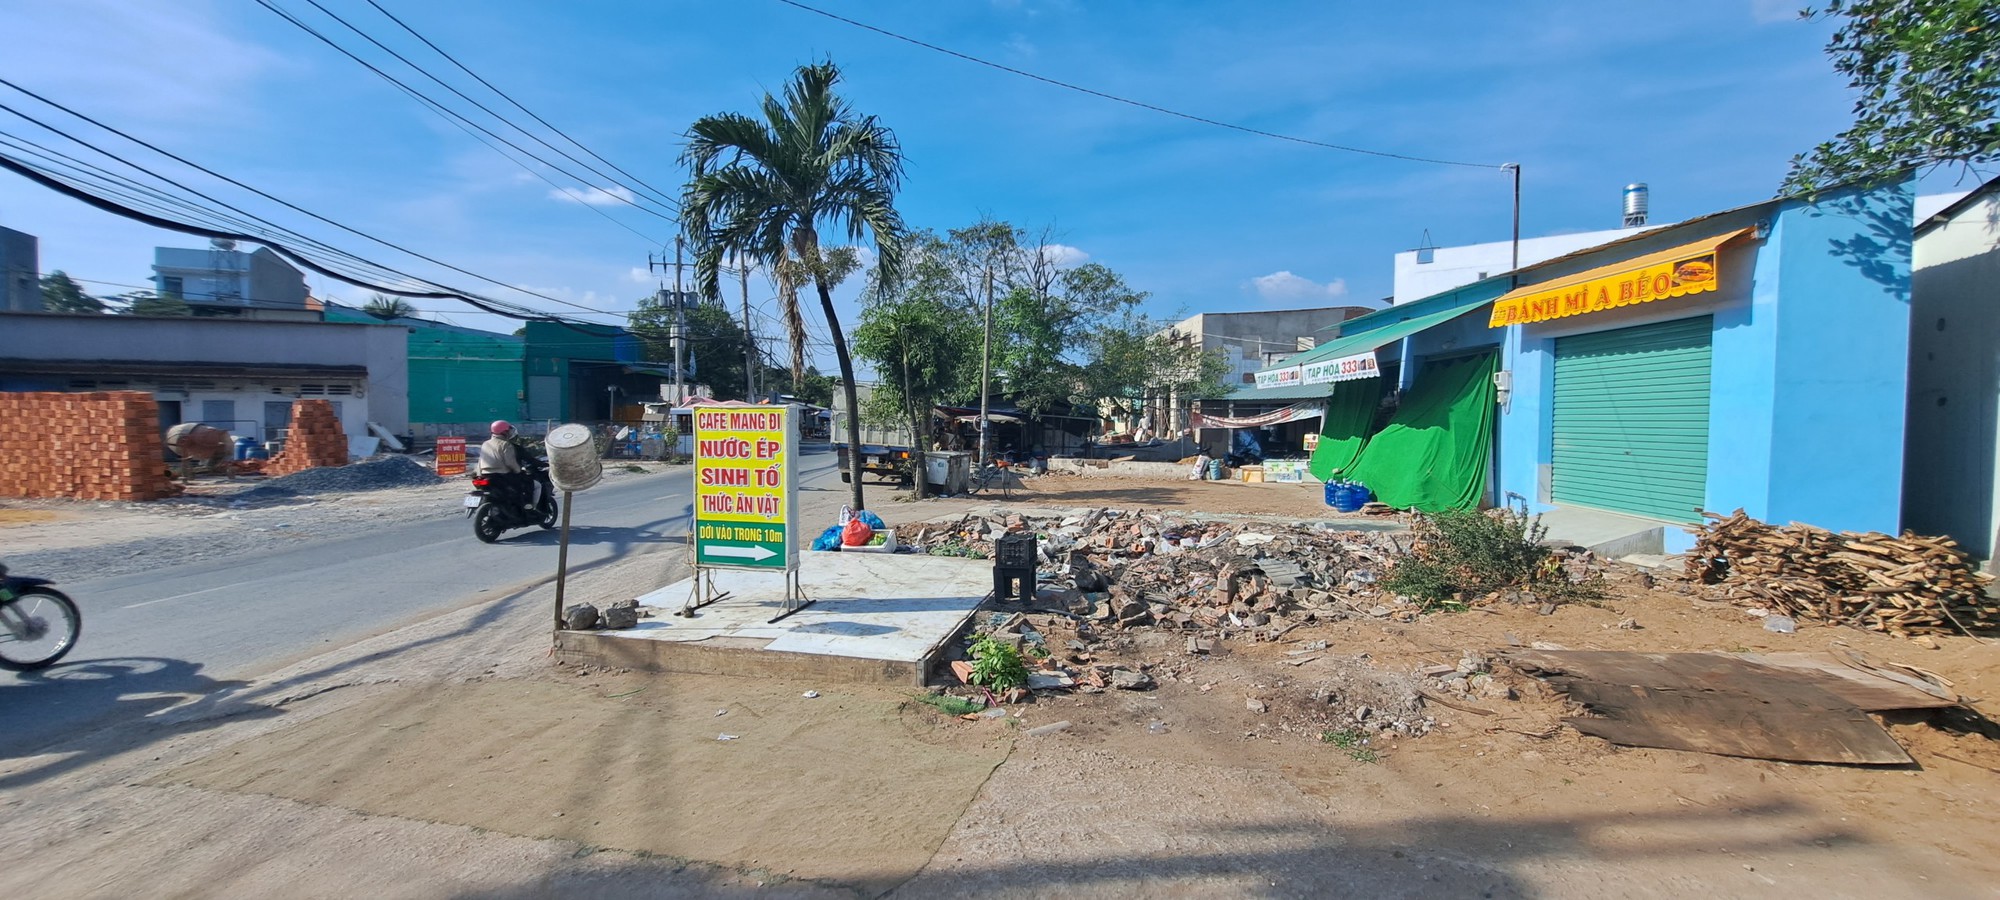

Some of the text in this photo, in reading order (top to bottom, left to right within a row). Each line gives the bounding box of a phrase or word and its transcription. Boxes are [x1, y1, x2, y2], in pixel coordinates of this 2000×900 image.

[1506, 296, 1559, 322] BÁNH
[1565, 284, 1588, 313] MÌ
[1595, 286, 1611, 307] A
[1618, 271, 1671, 303] BÉO
[1279, 371, 1289, 382] 333
[1341, 359, 1358, 374] 333
[698, 412, 781, 430] CAFE MANG ĐI
[700, 437, 780, 458] NƯỚC ÉP
[701, 463, 781, 486] SINH TỐ
[702, 492, 779, 518] THỨC ĂN VẶT
[716, 524, 732, 540] VÀO
[734, 527, 762, 542] TRONG
[764, 529, 783, 543] 10m
